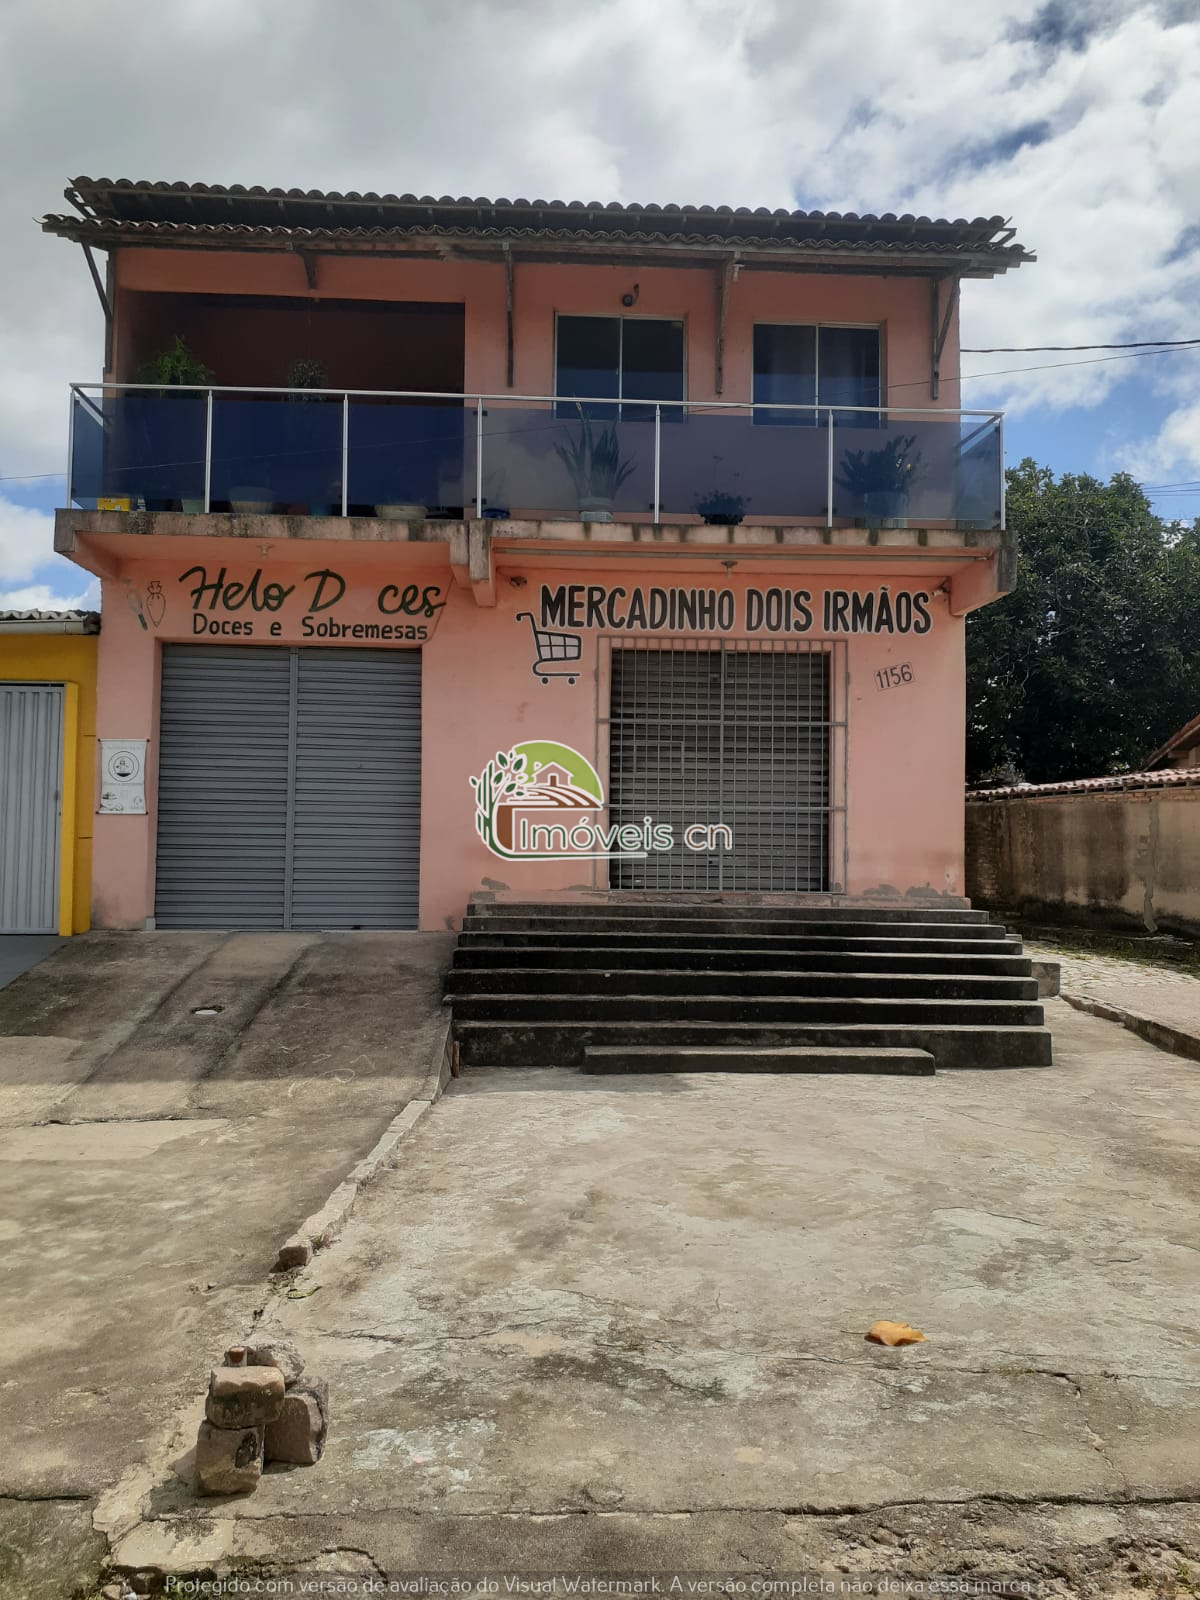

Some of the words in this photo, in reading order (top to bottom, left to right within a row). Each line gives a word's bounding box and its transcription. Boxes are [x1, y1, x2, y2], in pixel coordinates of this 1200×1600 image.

[178, 565, 295, 612] Helo
[192, 613, 254, 636] Doces
[270, 618, 282, 637] e
[301, 616, 429, 641] Sobremesas
[540, 584, 735, 633] MERCADINHO
[745, 587, 813, 633] DOIS
[822, 586, 933, 635] IRMÃOS
[876, 664, 912, 689] 1156
